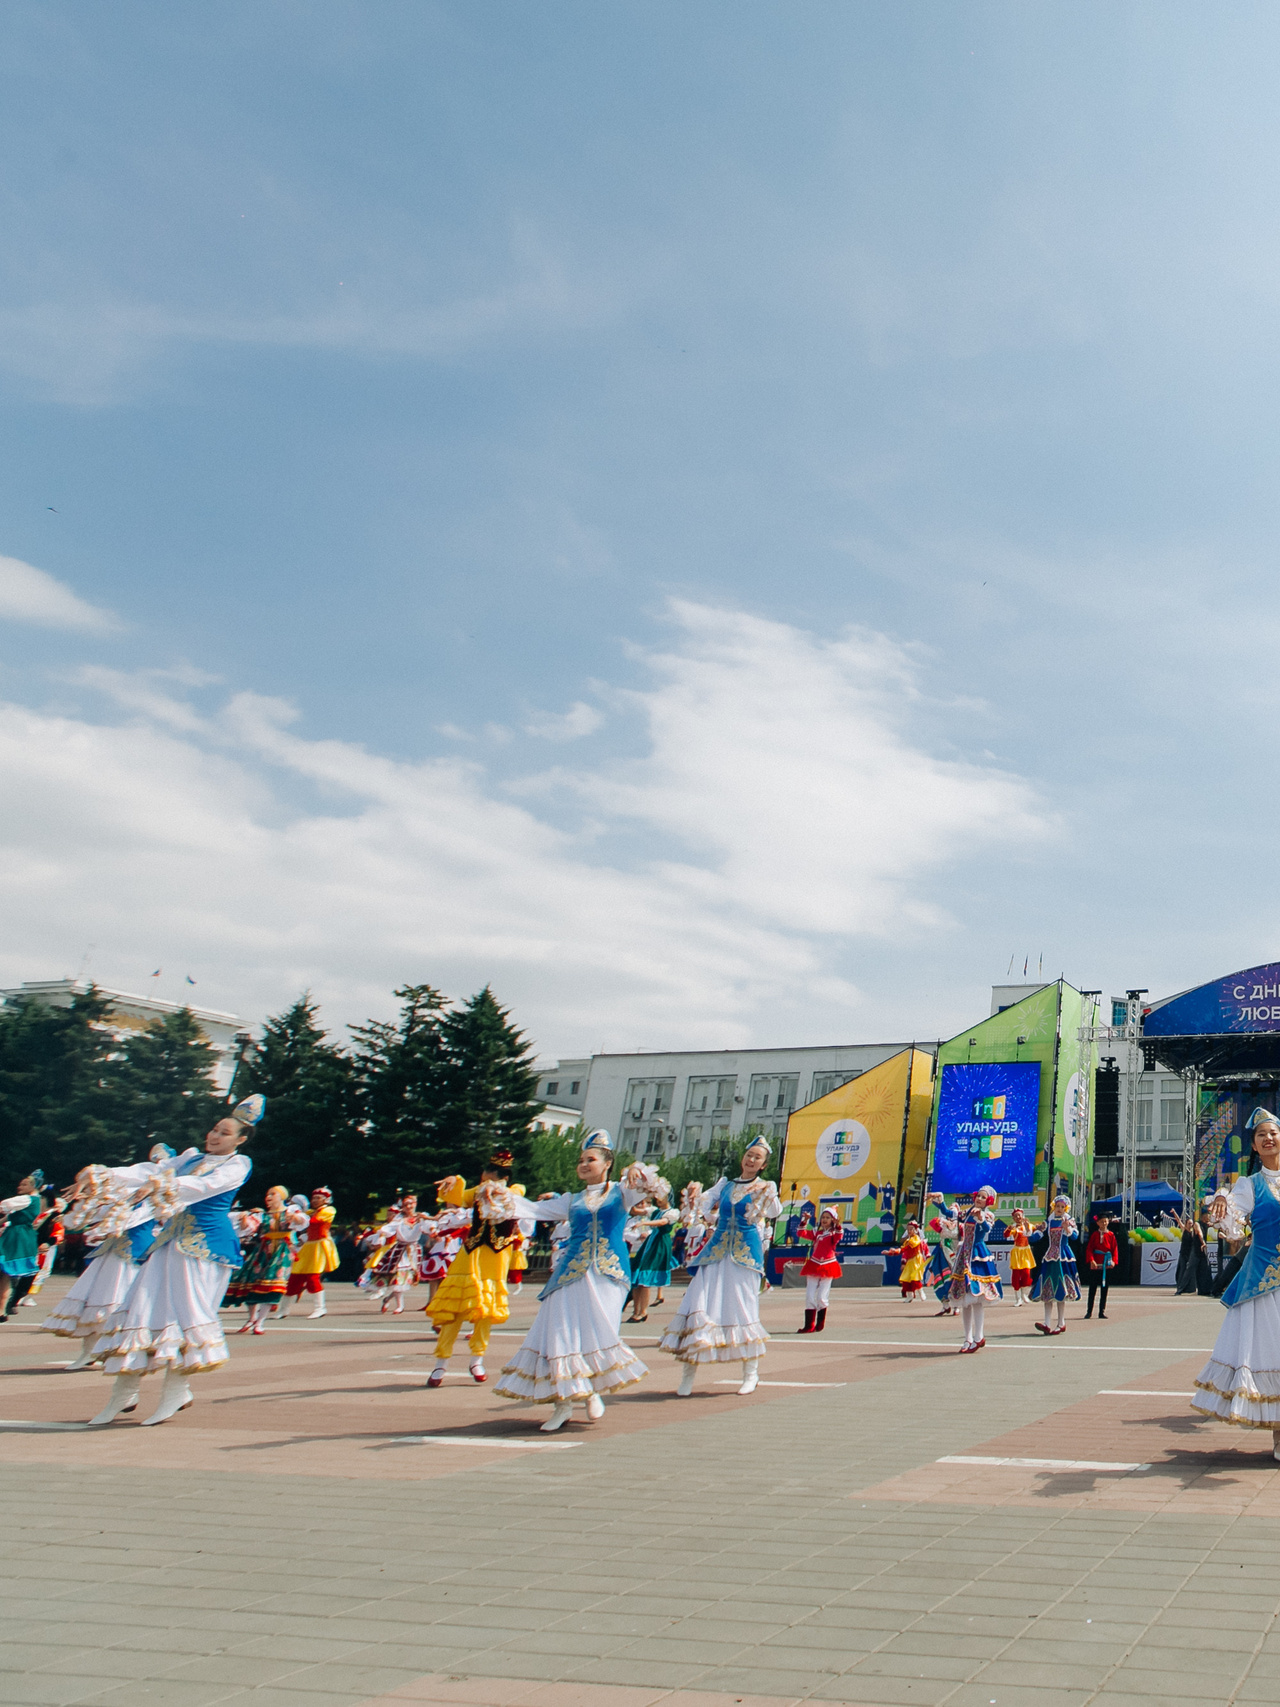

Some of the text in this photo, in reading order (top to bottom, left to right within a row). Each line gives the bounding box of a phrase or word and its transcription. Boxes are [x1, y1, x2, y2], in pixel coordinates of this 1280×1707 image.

[1233, 985, 1246, 999] С
[957, 1121, 1018, 1134] УЛАН-УДЭ
[969, 1137, 1003, 1153] 350
